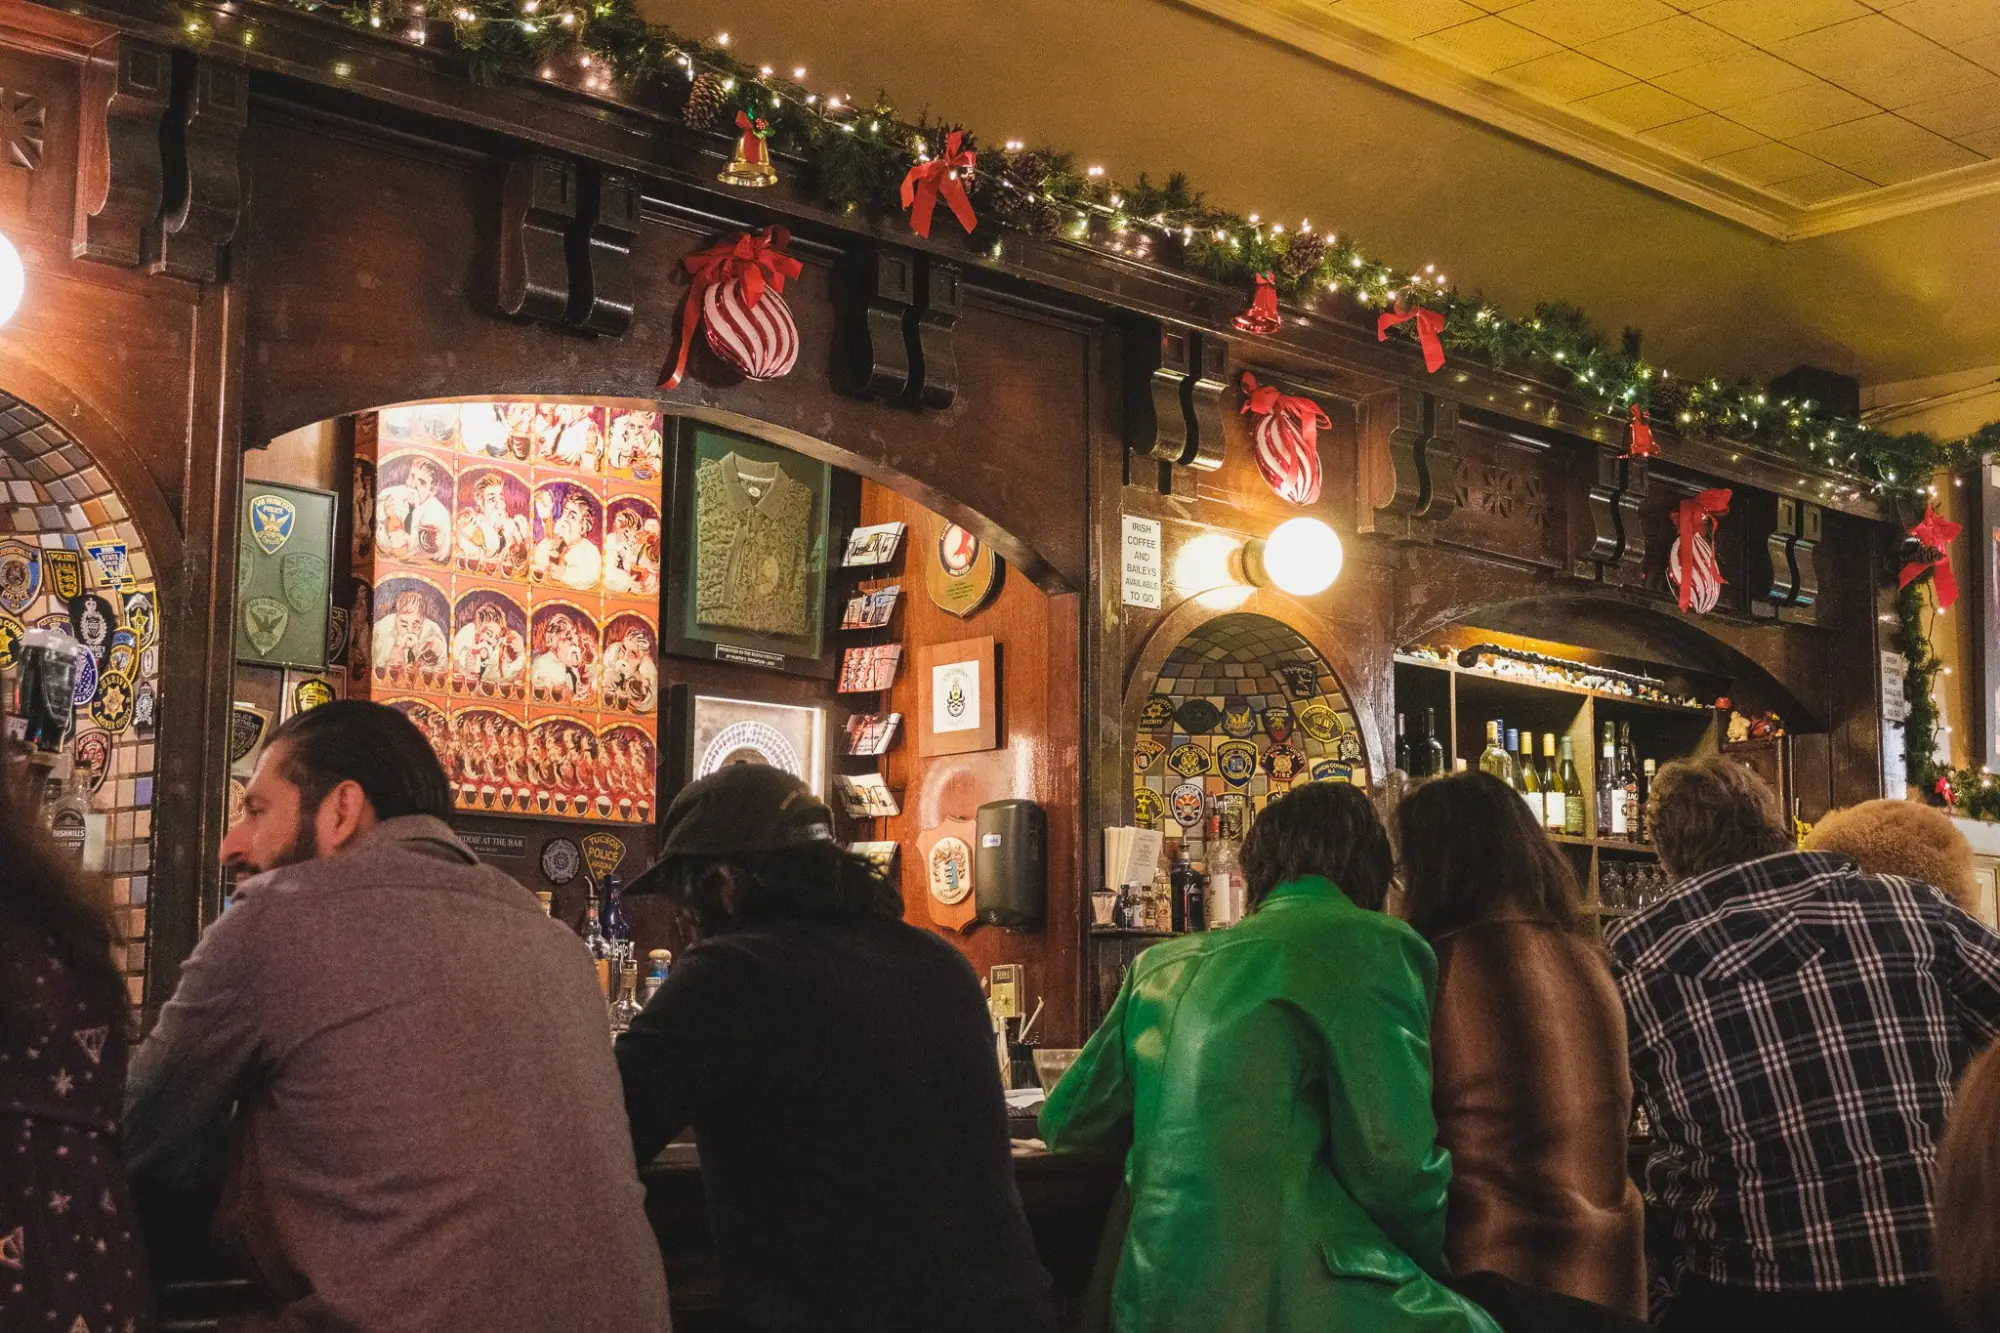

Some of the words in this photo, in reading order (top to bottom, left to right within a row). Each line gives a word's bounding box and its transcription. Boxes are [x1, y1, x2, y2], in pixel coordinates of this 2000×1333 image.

[263, 505, 283, 515] POLICE
[1132, 522, 1151, 533] IRISH
[1127, 535, 1156, 549] COFFEE
[1134, 551, 1150, 562] AND
[1126, 563, 1157, 577] BAILEYS
[1125, 577, 1158, 590] AVAILABLE
[1, 590, 30, 602] POLICE
[1130, 591, 1140, 601] TO
[1142, 593, 1154, 603] GO
[1884, 667, 1900, 676] COFFEE
[234, 712, 253, 721] OLICE
[1174, 746, 1189, 757] SAN
[1192, 746, 1208, 761] JOSE
[1286, 745, 1304, 764] COUNTY
[1330, 762, 1351, 772] COUNTY
[1274, 771, 1291, 779] FIRE
[53, 829, 85, 838] BUSHMILLS
[482, 836, 493, 846] AT
[493, 837, 507, 847] THE
[508, 839, 524, 847] BAR
[588, 836, 621, 851] TUCSON
[588, 847, 619, 861] POLICE
